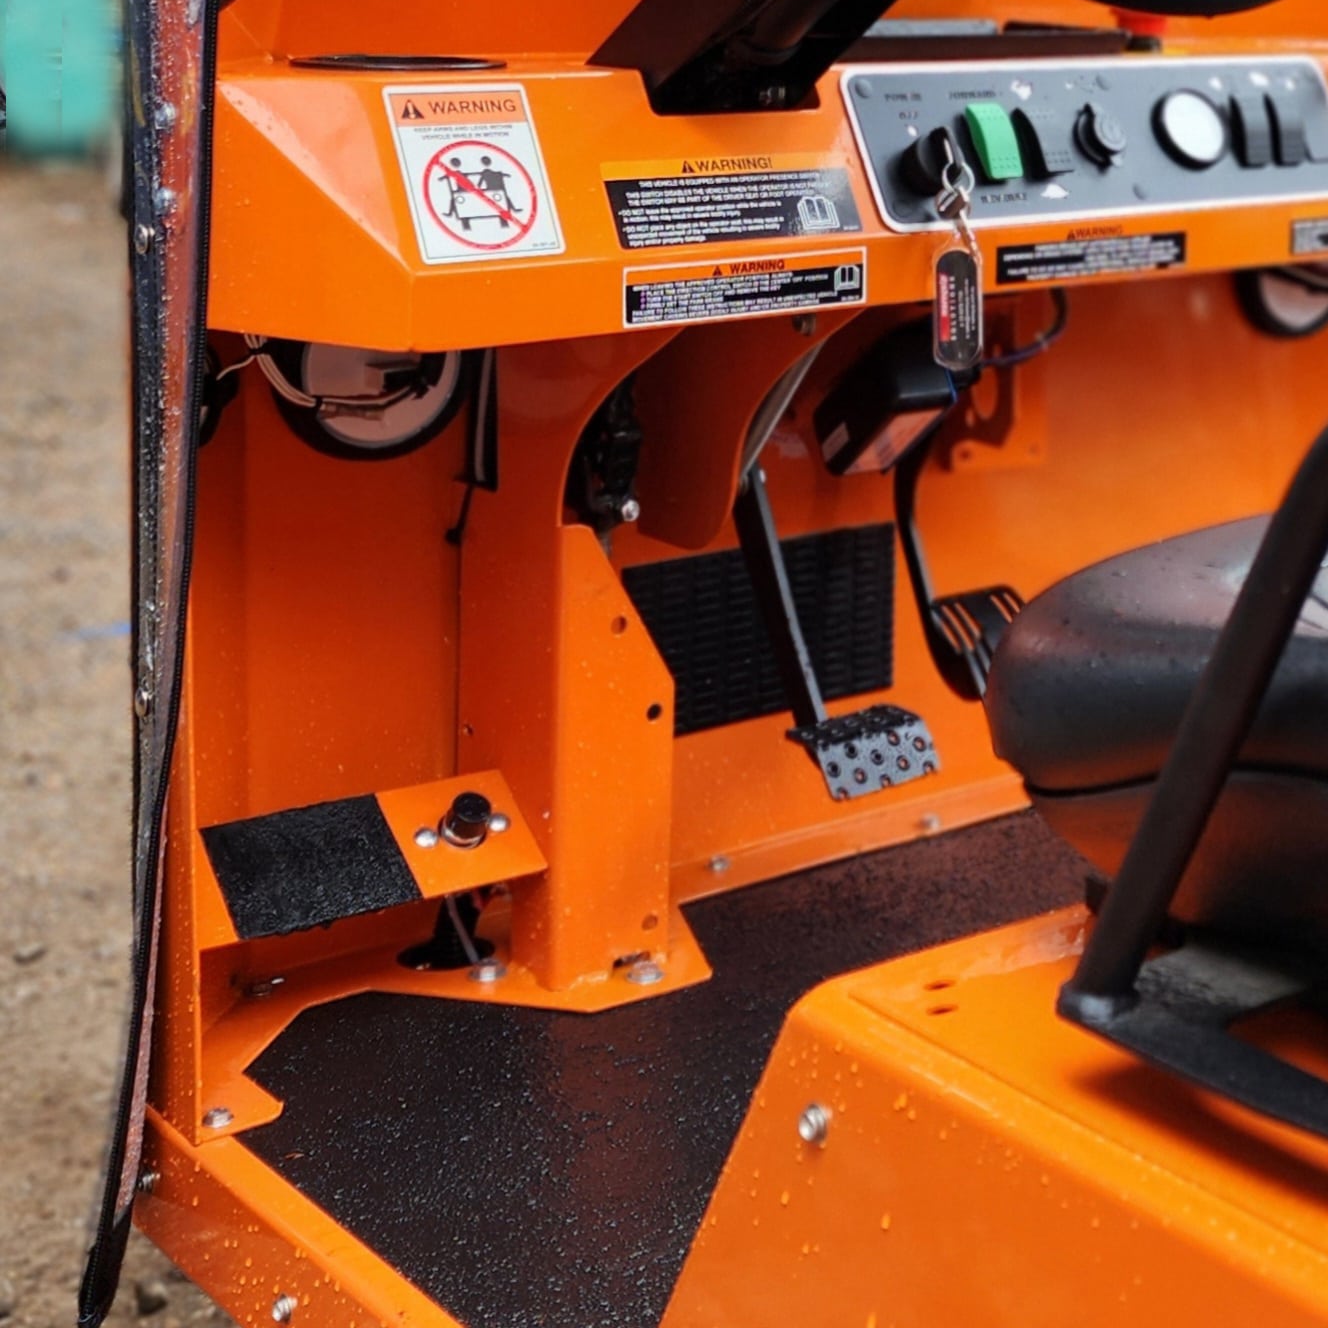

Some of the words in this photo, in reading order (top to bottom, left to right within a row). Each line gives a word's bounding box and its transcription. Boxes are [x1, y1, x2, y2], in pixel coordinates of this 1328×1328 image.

[428, 99, 516, 115] WARNING
[695, 157, 773, 172] WARNING!
[1075, 226, 1123, 238] WARNING
[730, 259, 785, 274] WARNING
